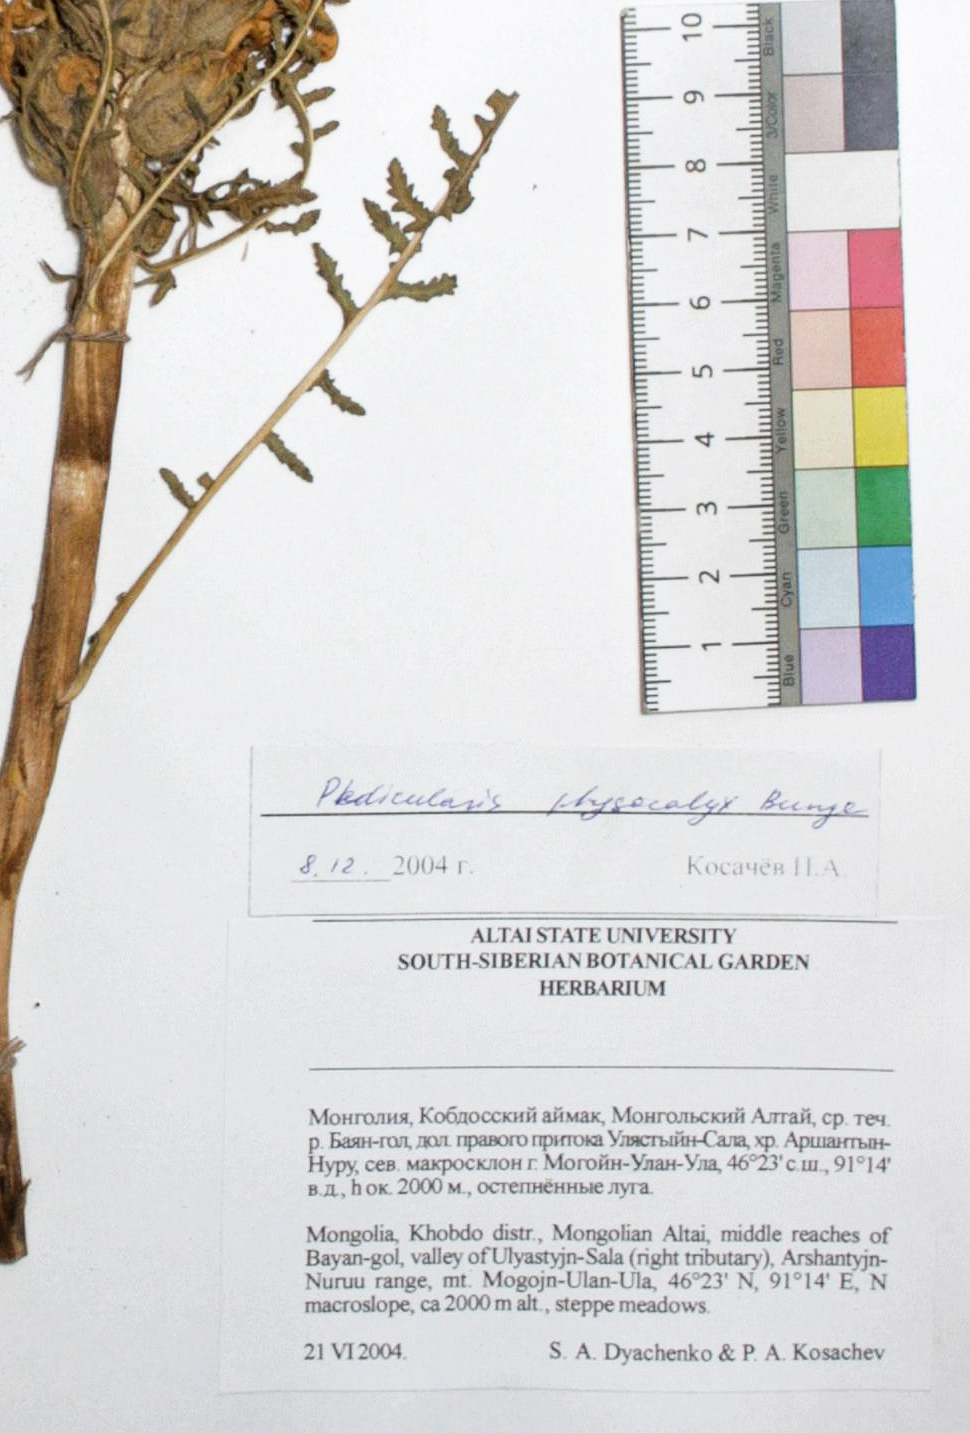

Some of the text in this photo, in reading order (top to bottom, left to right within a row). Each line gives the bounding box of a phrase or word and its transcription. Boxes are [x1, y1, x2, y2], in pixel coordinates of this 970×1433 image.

[681, 13, 702, 42] 10
[683, 90, 704, 104] 9
[685, 159, 706, 173] 8
[769, 175, 778, 214] White
[687, 228, 708, 242] 7
[770, 243, 784, 303] Magenta
[690, 296, 711, 310] 6
[773, 338, 784, 365] Red
[692, 364, 713, 378] 5
[694, 432, 714, 448] 4
[776, 408, 787, 454] Yellow
[696, 501, 717, 515] 3
[779, 491, 789, 534] Green
[698, 570, 720, 584] 2
[782, 572, 794, 607] Cyan
[701, 643, 722, 651] 1
[783, 655, 794, 686] Blue
[393, 855, 449, 876] 2004
[687, 856, 784, 877] Косачёв
[471, 927, 736, 944] ALTAI STATE UNIVERSITY
[398, 953, 809, 970] SOUTH-SIBERIAN BOTANICAL GARDEN
[540, 980, 665, 996] HERBARIUM
[309, 1106, 890, 1130] Монголия, Кобдосский аймак, Монгольский Алтай, ср. теч.
[309, 1137, 323, 1153] р.
[329, 1132, 412, 1150] Баян-гол,
[457, 1135, 528, 1152] правого
[532, 1135, 602, 1151] притока
[609, 1130, 750, 1150] Улястыйн-Сала,
[755, 1136, 778, 1152] хр.
[784, 1132, 890, 1150] Аршантын-
[308, 1155, 359, 1176] Нуру,
[365, 1160, 397, 1172] сев.
[407, 1158, 522, 1176] макросклон
[544, 1153, 722, 1172] Могойн-Улан-Ула,
[398, 1178, 443, 1195] 2000
[477, 1179, 604, 1194] остепнённые
[608, 1182, 653, 1198] луга.
[307, 1224, 892, 1246] Mongolia, Khobdo distr., Mongolian Altai, middle reaches of
[306, 1247, 887, 1270] Bayan-gol, valley of Ulyastyjn-Sala (right tributary), Arshantyjn-
[306, 1270, 887, 1293] Nuruu range, mt. Mogojn-Ulan-Ula, 46°23' N, 91°14' E, N
[305, 1294, 709, 1317] macroslope, ca 2000 m alt., steppe meadows.
[304, 1343, 405, 1360] 21 VI 2004.
[550, 1341, 885, 1365] S. A. Dyachenko & P. A. Kosachev
